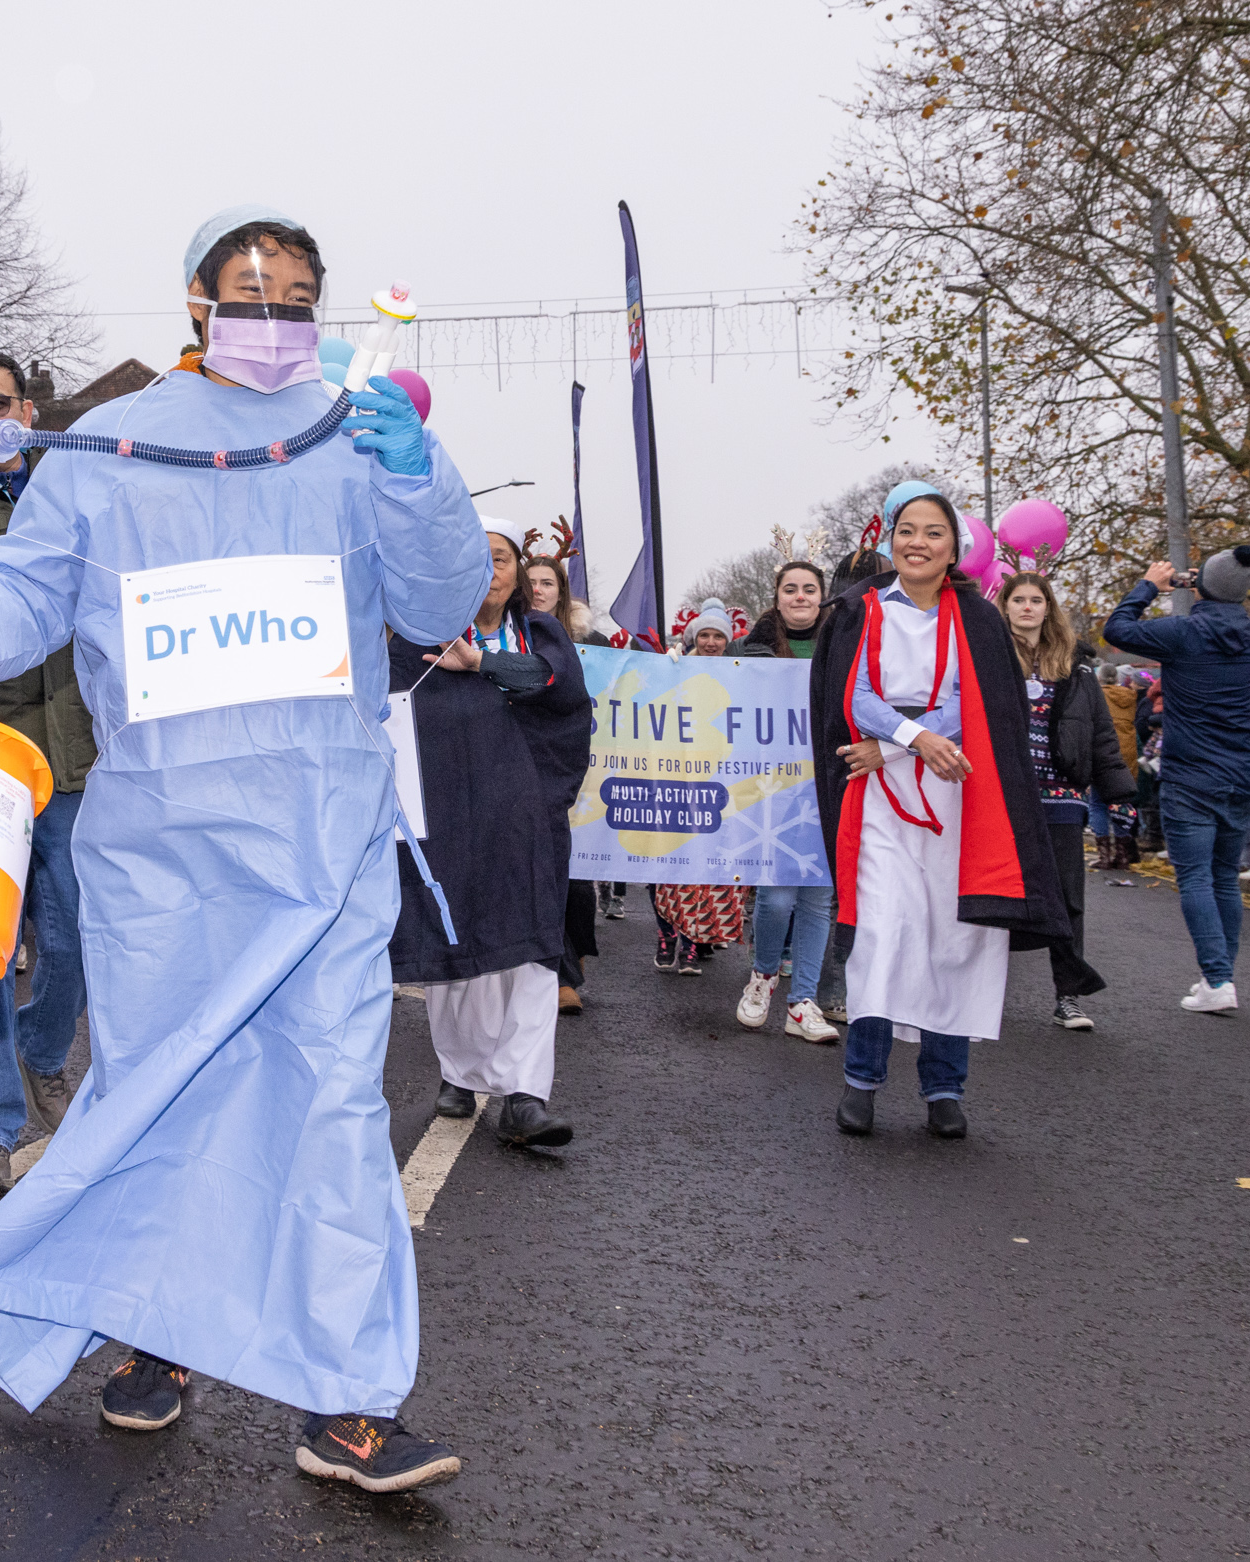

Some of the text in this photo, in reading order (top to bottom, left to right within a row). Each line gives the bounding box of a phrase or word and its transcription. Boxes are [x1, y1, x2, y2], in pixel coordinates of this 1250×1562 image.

[165, 586, 187, 595] Hospital
[187, 583, 207, 591] Charity
[145, 609, 318, 661] Dr Who
[726, 706, 808, 746] FUN
[603, 755, 628, 770] JOIN
[634, 757, 648, 771] US
[658, 758, 681, 773] FOR
[685, 760, 711, 774] OUR
[717, 761, 771, 776] FESTIVE
[778, 762, 802, 776] FUN
[611, 785, 718, 804] MULTI ACTIVITY
[613, 807, 713, 826] HOLIDAY CLUB
[578, 852, 588, 860] FRI
[590, 853, 599, 861] 22
[600, 854, 612, 862] DEC
[627, 855, 640, 863] WED
[657, 856, 667, 864] FRI
[679, 857, 690, 865] DEC
[723, 858, 727, 866] 2
